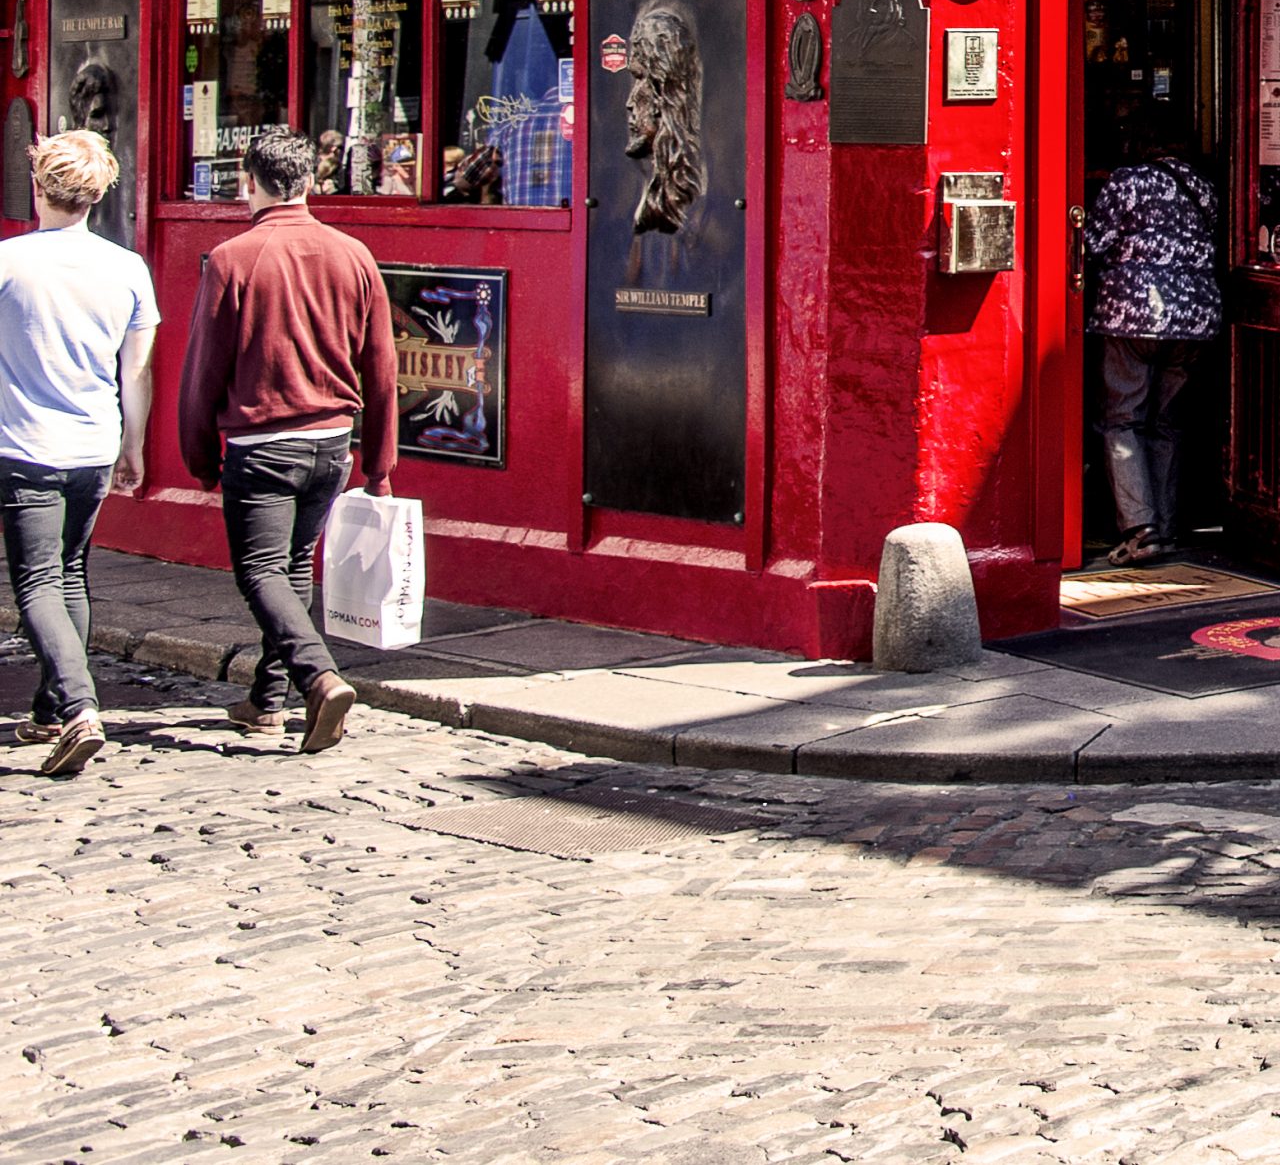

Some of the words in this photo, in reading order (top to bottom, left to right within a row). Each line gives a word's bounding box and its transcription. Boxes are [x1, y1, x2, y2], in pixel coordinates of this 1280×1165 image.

[62, 18, 75, 32] THE
[78, 16, 107, 32] TEMPLE
[108, 15, 124, 29] BAR
[615, 290, 629, 303] SIR
[630, 291, 669, 306] WILLIAM
[671, 294, 706, 308] TEMPLE
[399, 349, 467, 381] HISKEY
